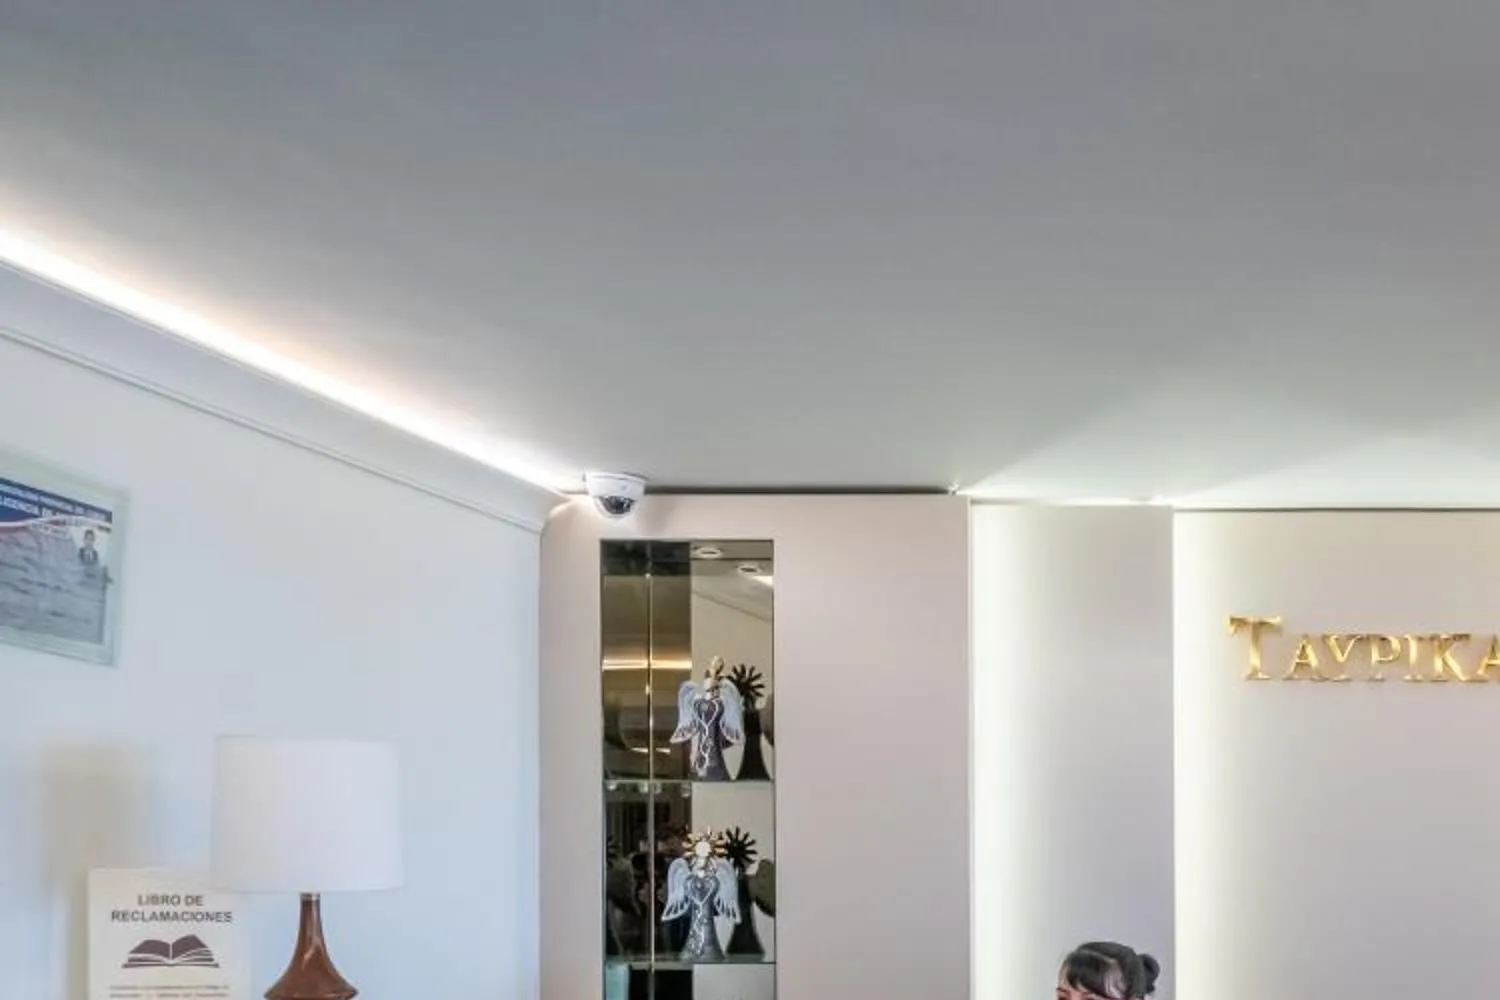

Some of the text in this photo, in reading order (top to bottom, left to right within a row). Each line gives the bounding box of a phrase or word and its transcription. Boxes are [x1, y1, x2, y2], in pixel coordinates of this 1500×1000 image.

[138, 894, 204, 906] LIBRO DE
[111, 910, 232, 922] RECLAMACIONES
